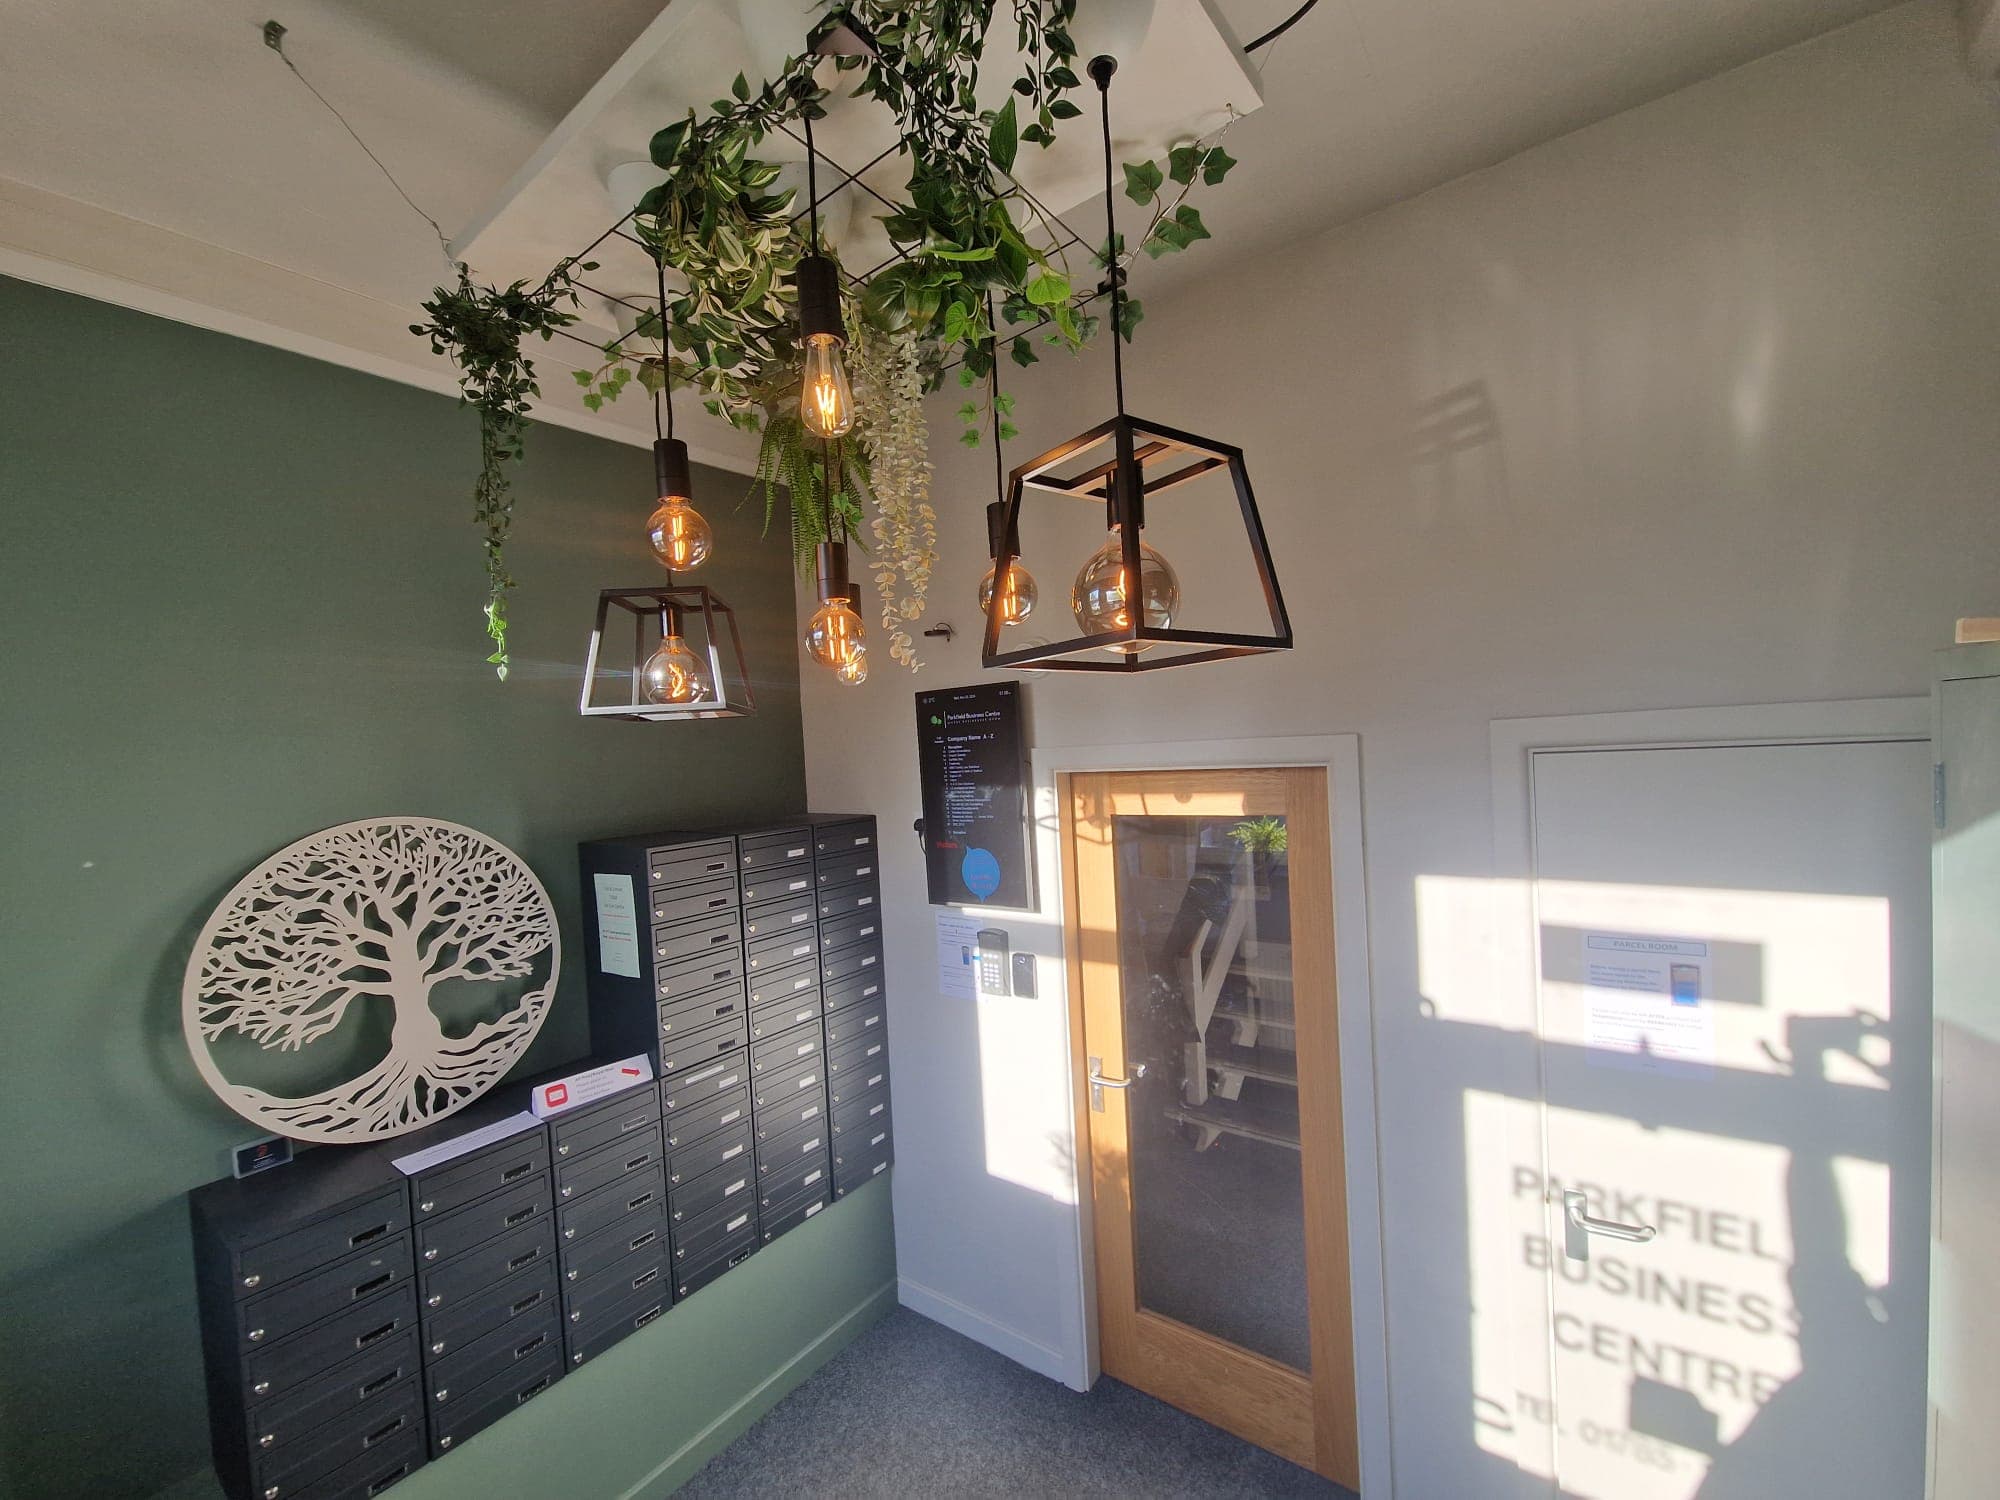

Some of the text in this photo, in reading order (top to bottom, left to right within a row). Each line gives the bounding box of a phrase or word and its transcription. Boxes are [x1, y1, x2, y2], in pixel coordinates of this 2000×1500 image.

[985, 709, 1001, 717] Centre
[947, 735, 968, 743] Company
[1614, 940, 1678, 951] PARCEL ROOM
[1554, 1311, 1784, 1404] CENTRE
